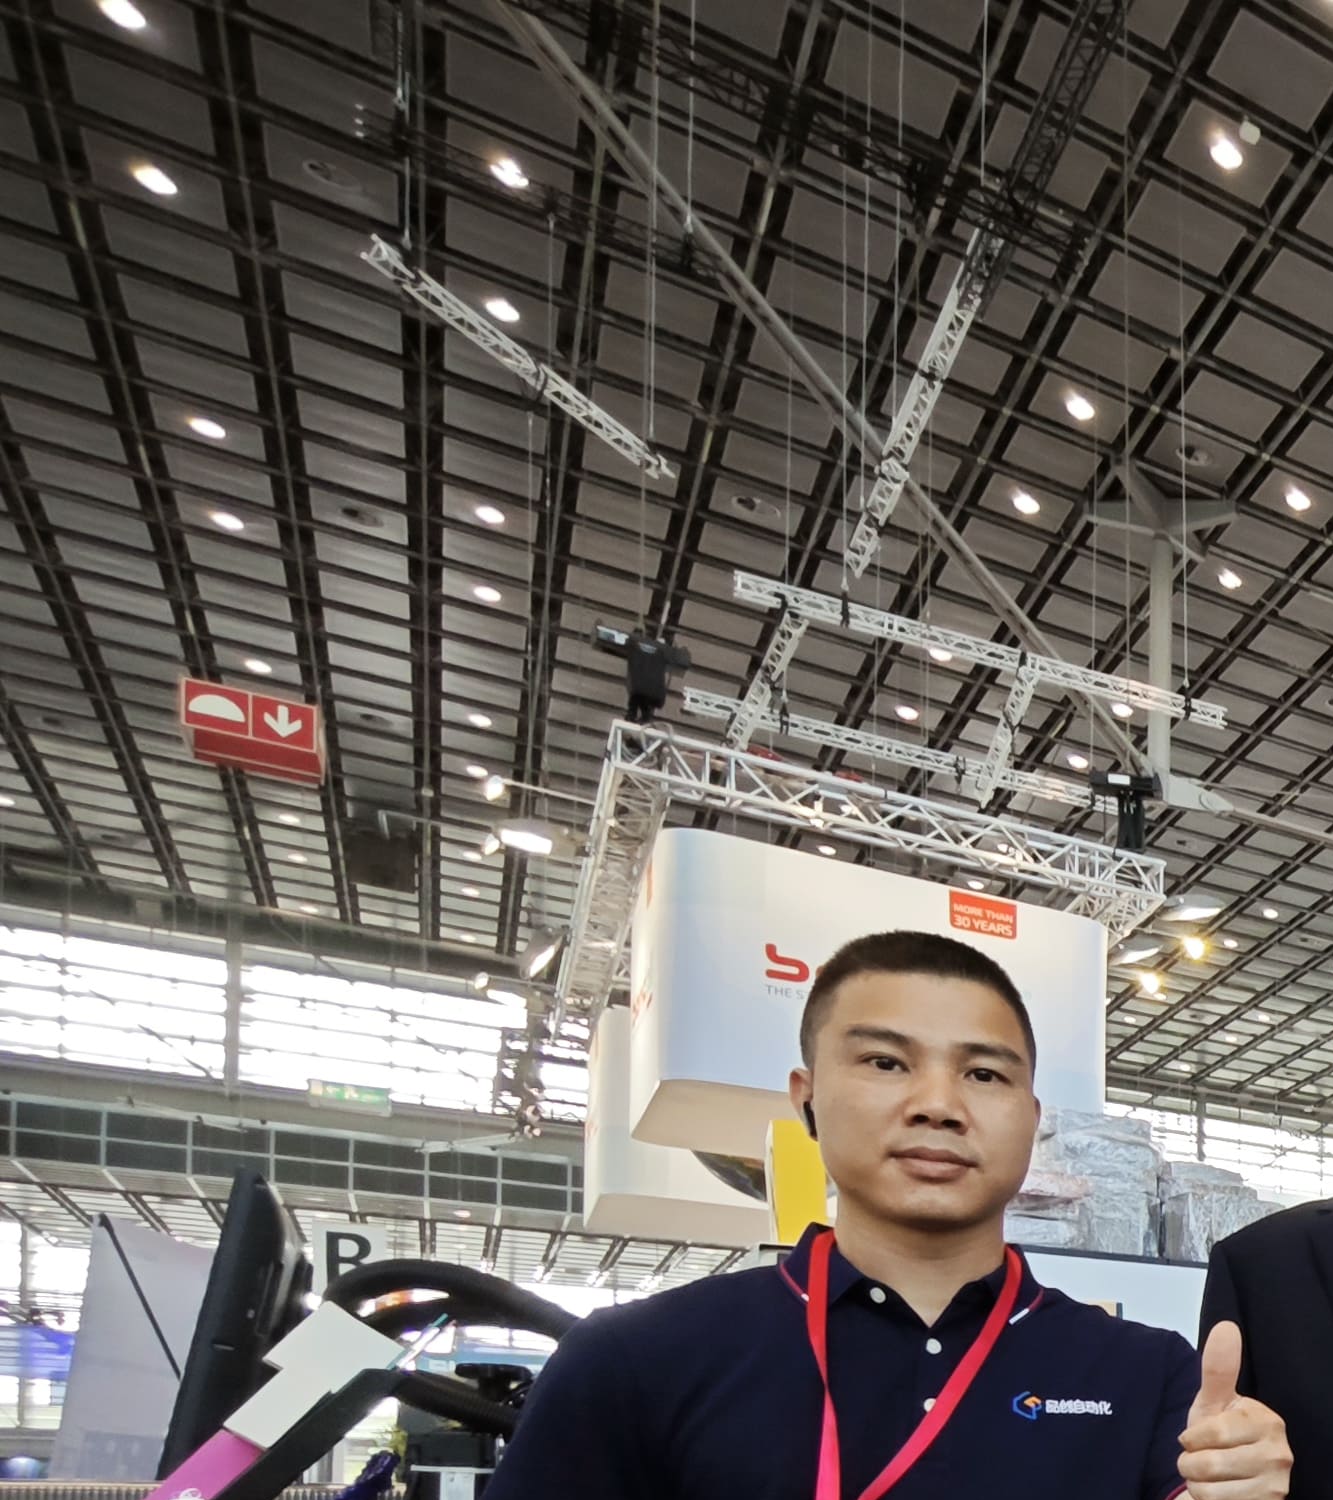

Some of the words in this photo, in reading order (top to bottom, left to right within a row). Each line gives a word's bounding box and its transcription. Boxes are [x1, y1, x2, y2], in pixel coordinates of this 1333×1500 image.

[952, 902, 983, 918] MORE
[985, 909, 1014, 925] THAN
[952, 914, 971, 930] 30
[973, 917, 1014, 938] YEARS
